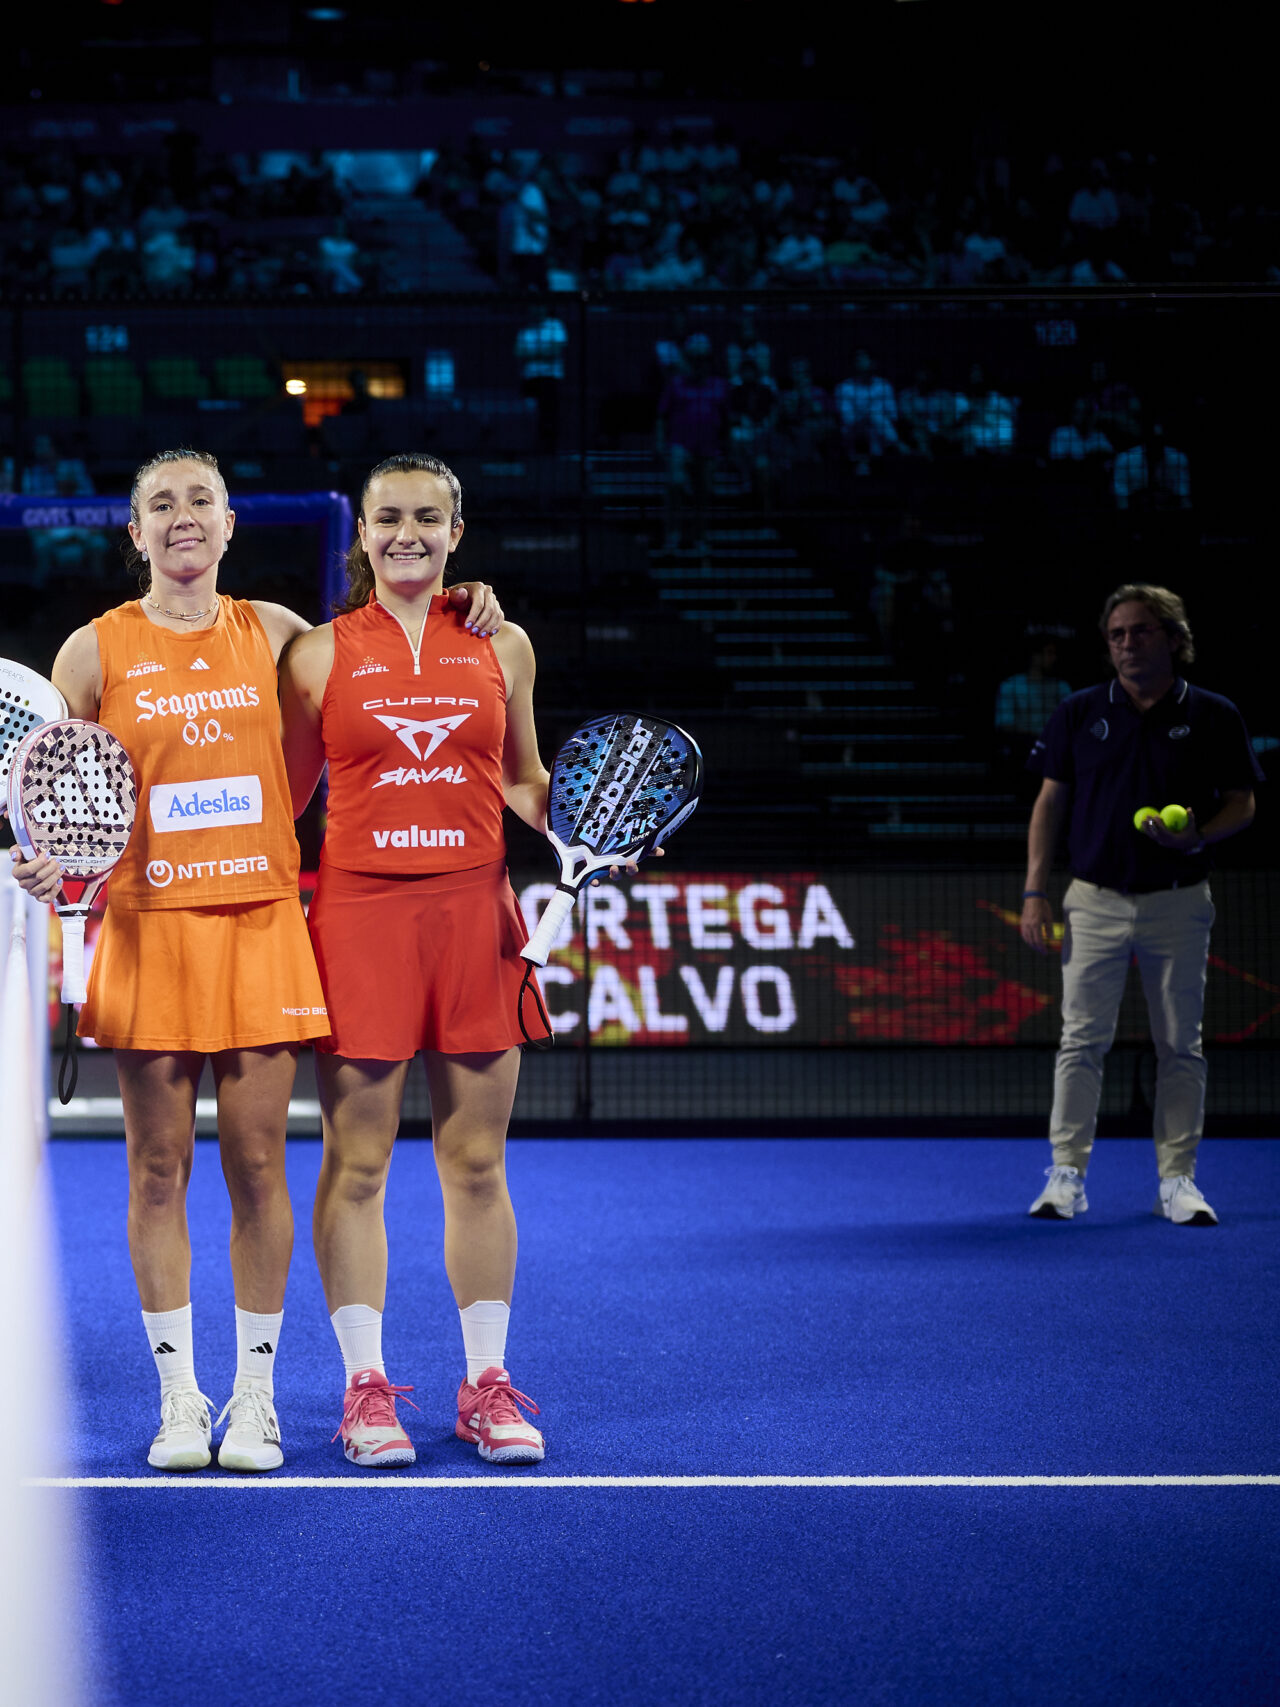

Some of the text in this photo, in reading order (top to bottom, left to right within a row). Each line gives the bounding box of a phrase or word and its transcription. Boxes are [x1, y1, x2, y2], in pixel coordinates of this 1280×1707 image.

[439, 657, 480, 666] OYSHO
[126, 664, 166, 679] PADEL
[352, 665, 390, 678] PADEL
[135, 683, 260, 723] Seagram's
[362, 696, 479, 710] CUPRA
[167, 788, 251, 818] Adeslas
[372, 825, 465, 848] valum
[177, 861, 217, 879] NTT
[540, 964, 798, 1034] CALVO
